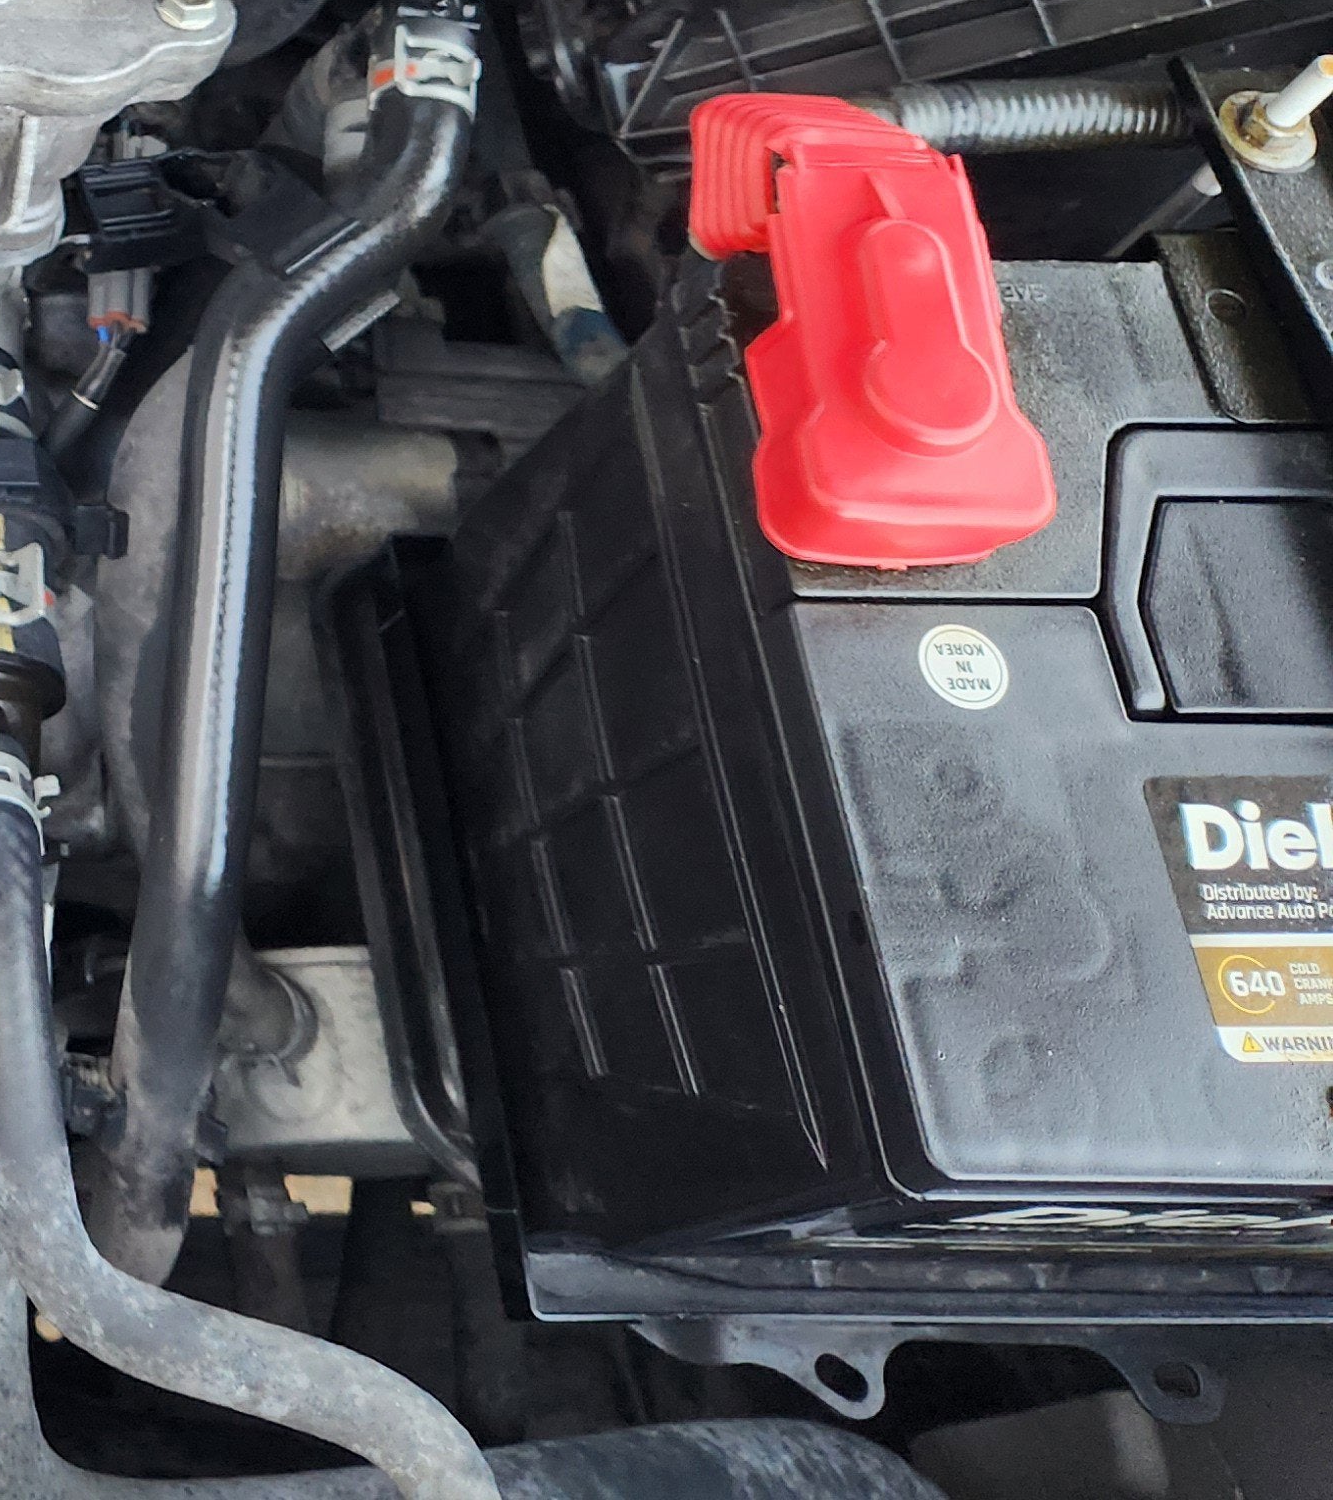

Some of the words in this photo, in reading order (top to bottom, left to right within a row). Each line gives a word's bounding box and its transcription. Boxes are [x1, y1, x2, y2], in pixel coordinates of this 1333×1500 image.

[933, 643, 985, 656] KOREA
[955, 660, 973, 674] IN
[946, 677, 991, 691] MADE
[1199, 882, 1291, 901] Distributed
[1293, 883, 1318, 904] by:
[1204, 902, 1275, 920] Advance
[1277, 902, 1315, 919] Auto
[1288, 962, 1320, 975] COLD
[1229, 970, 1286, 997] 640
